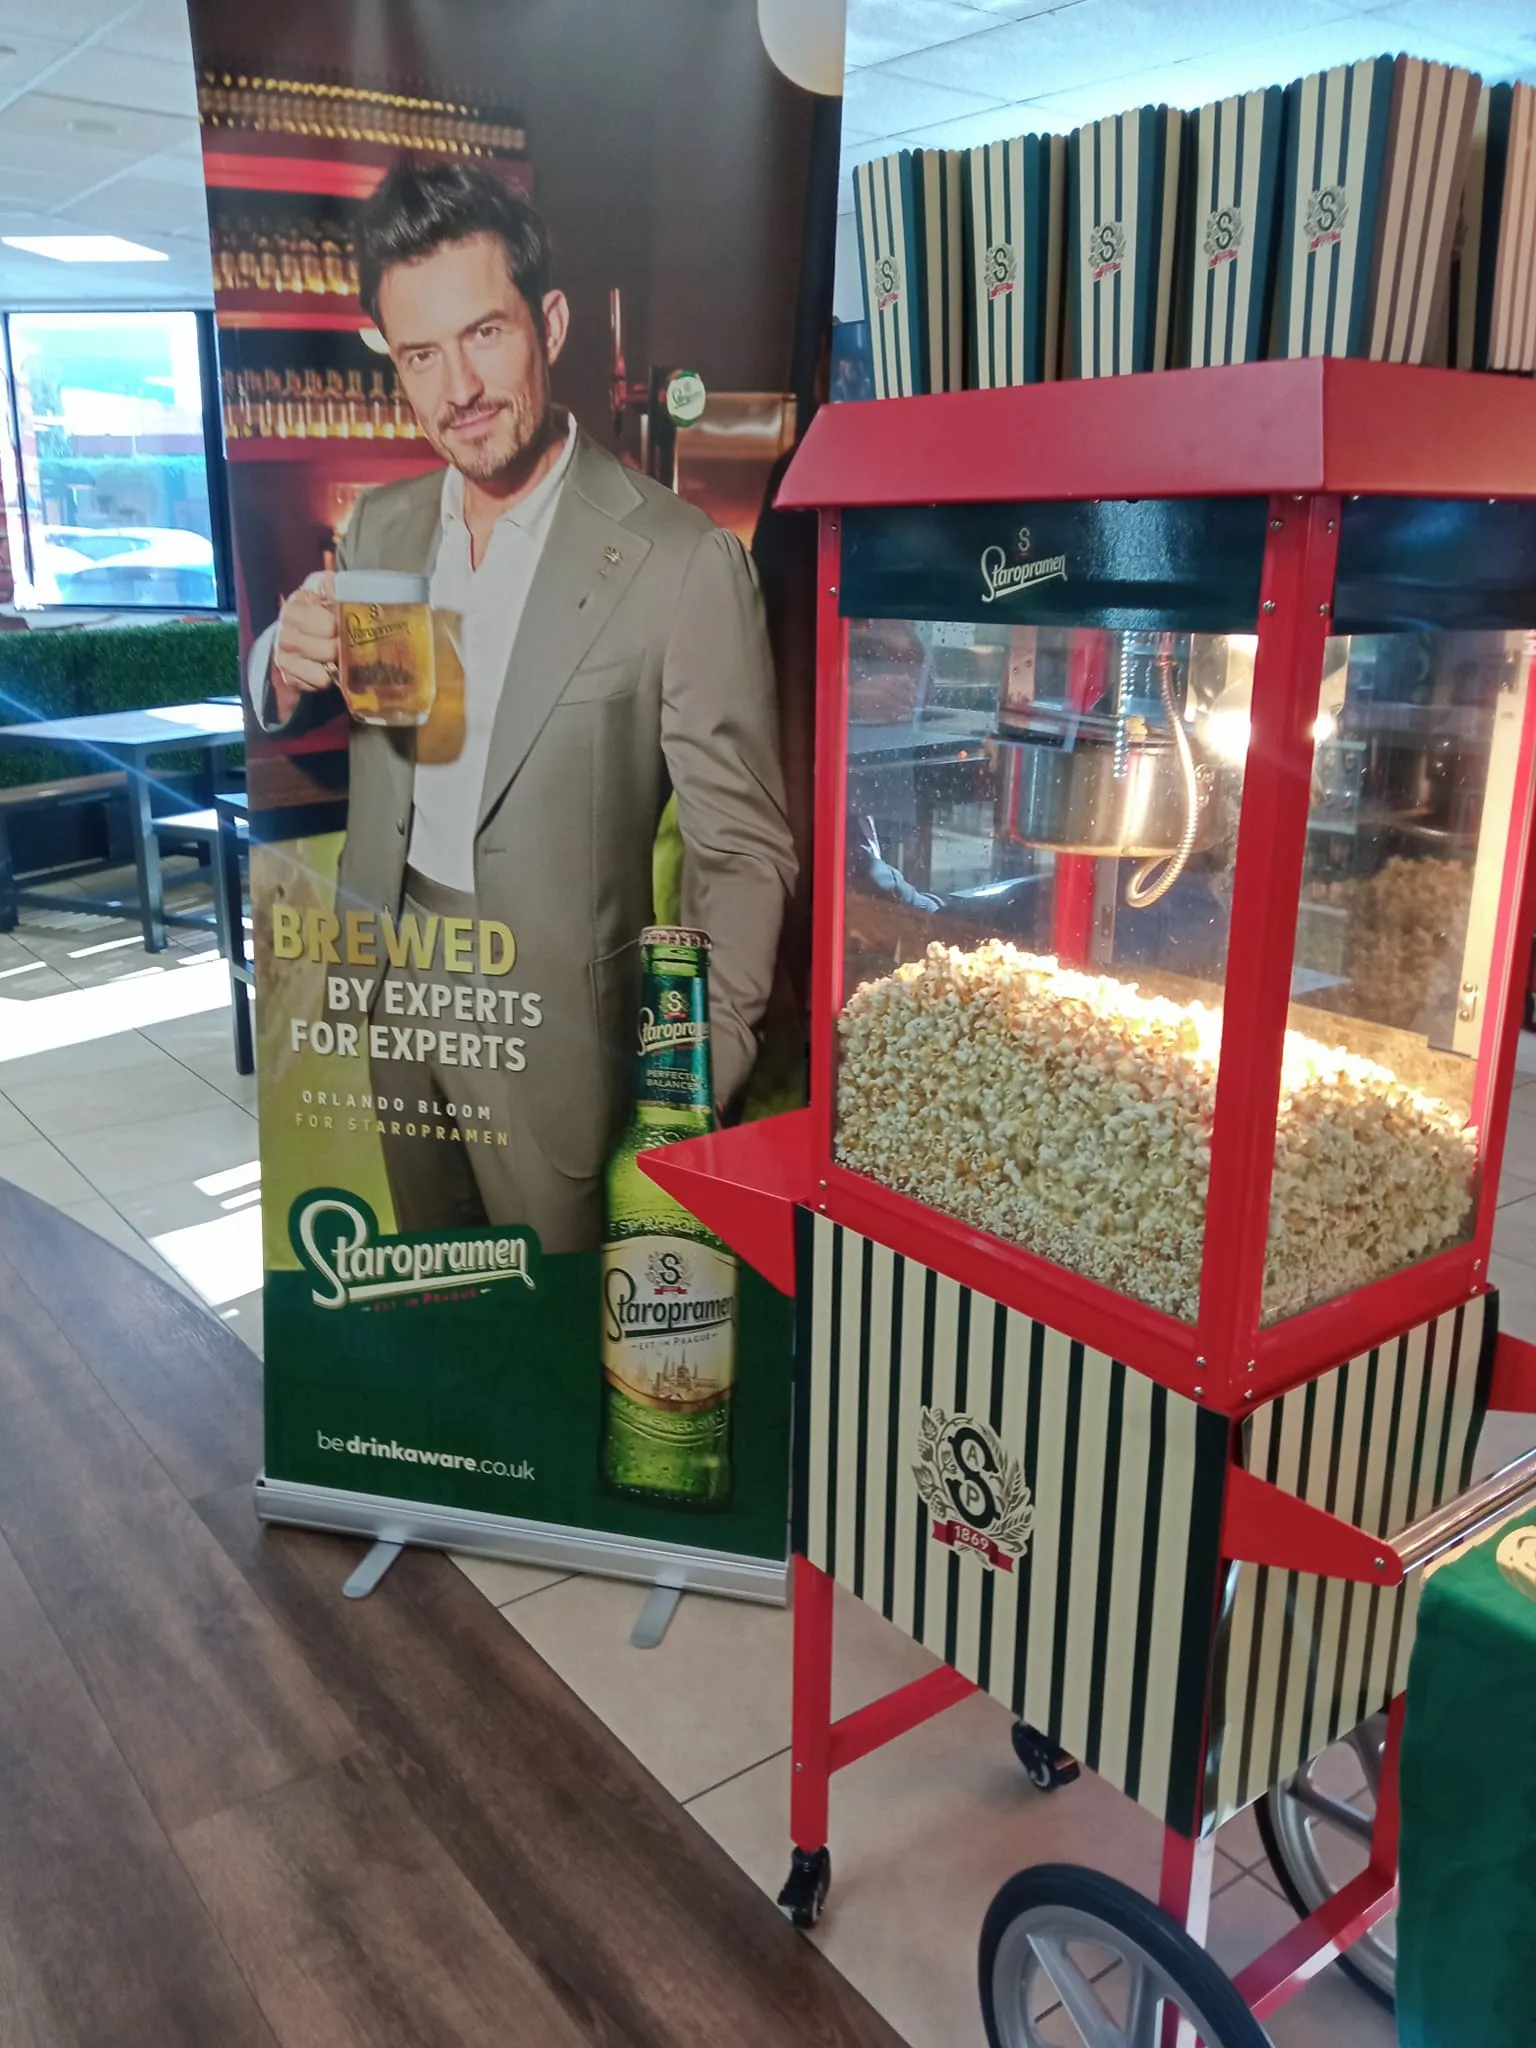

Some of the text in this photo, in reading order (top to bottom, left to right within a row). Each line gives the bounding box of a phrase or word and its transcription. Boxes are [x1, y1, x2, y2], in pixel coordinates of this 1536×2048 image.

[1018, 527, 1031, 552] S
[981, 545, 1068, 603] Staropramen
[272, 903, 517, 976] BREWED
[327, 976, 544, 1028] BY EXPERTS
[290, 1018, 528, 1073] FOR EXPERTS
[296, 1112, 509, 1147] FOR STAROPRAMEN
[302, 1090, 491, 1121] ORLANDO BLOOM
[300, 1199, 536, 1310] Staropramen
[946, 1426, 1002, 1529] S
[953, 1524, 990, 1551] 1869
